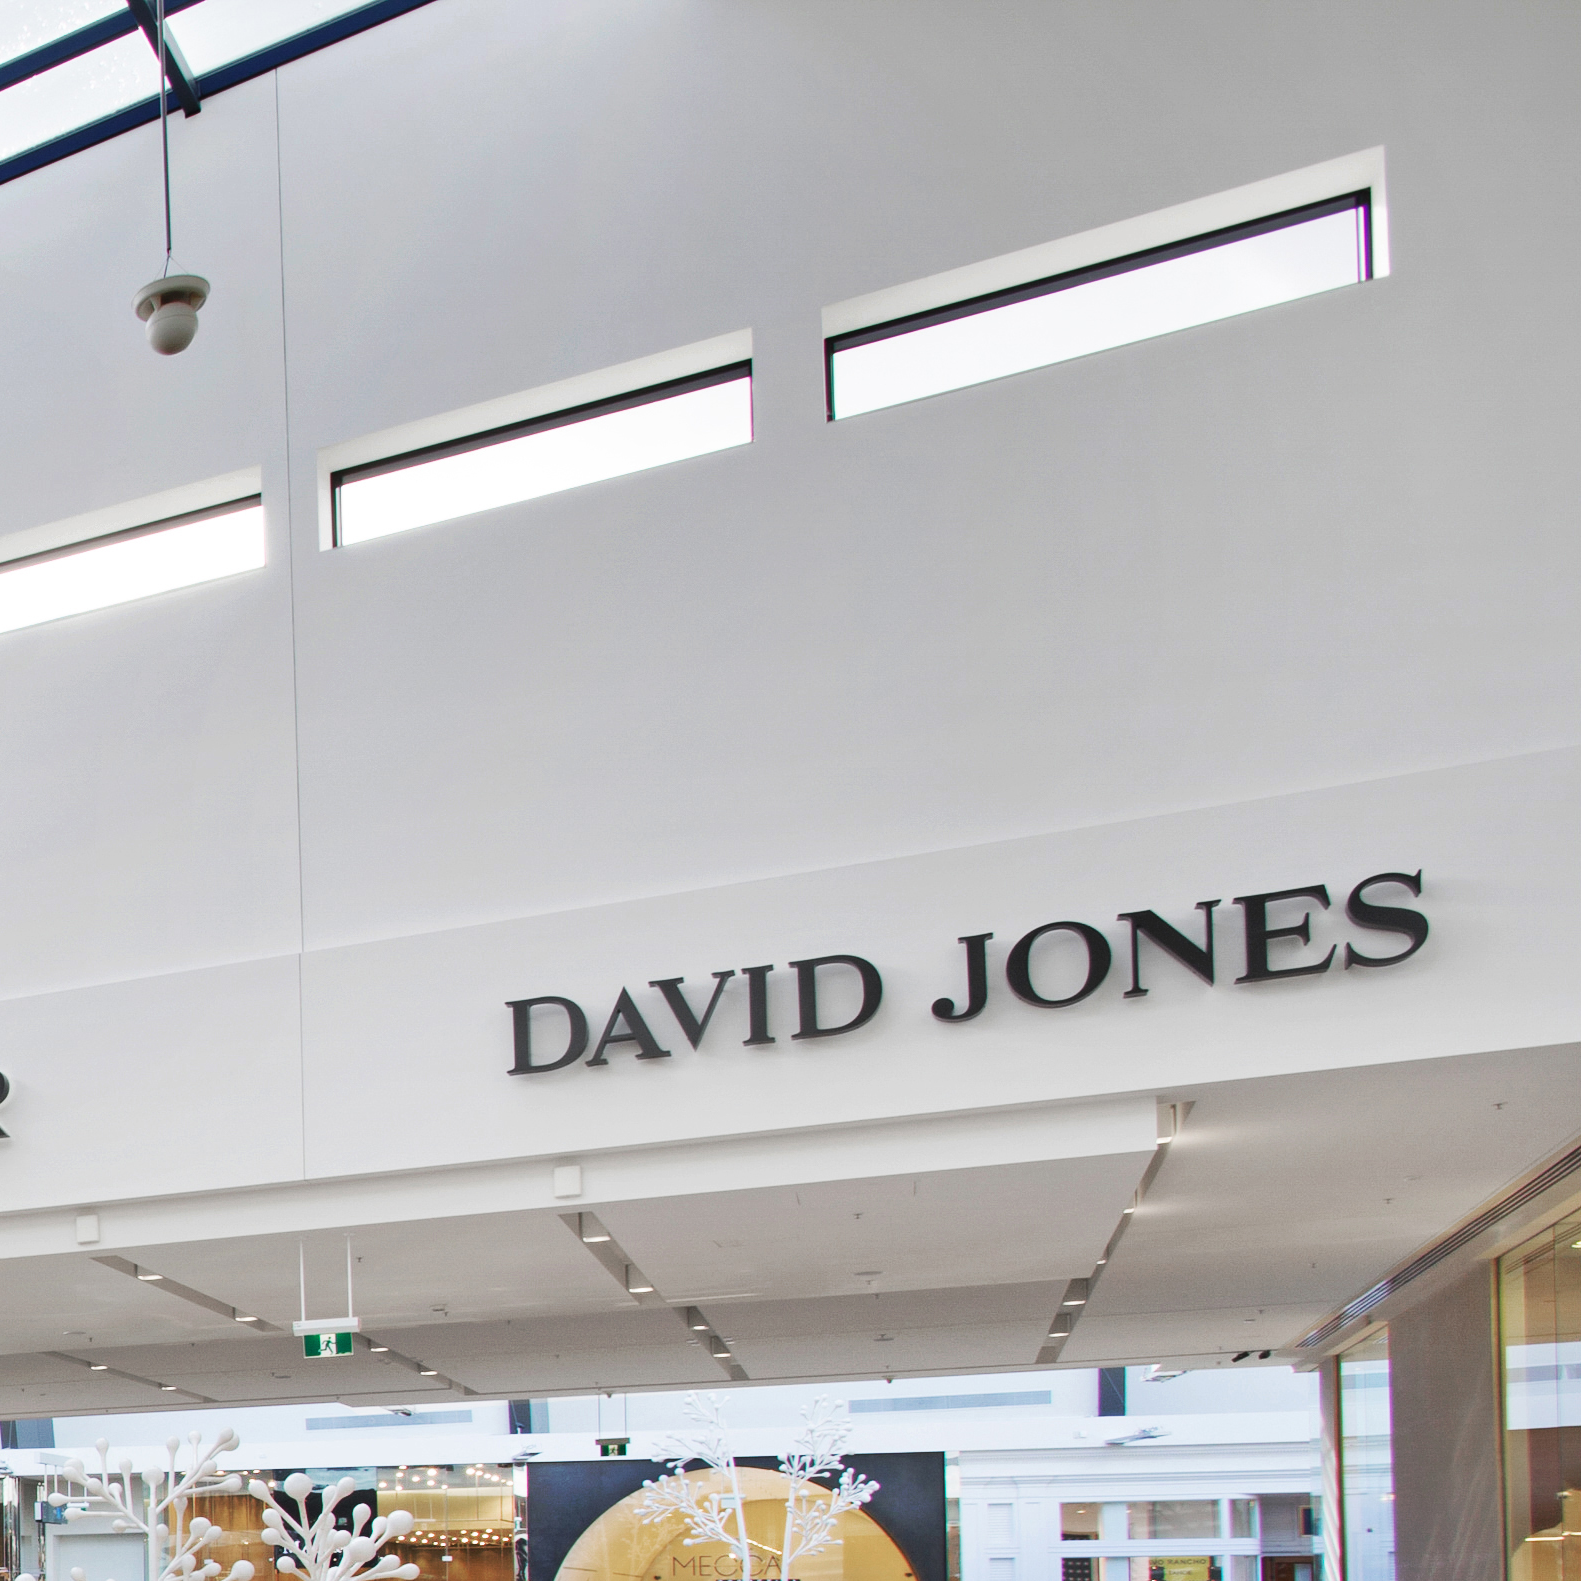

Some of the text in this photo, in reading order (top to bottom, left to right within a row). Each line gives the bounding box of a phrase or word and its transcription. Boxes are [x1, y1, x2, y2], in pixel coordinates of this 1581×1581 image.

[505, 869, 1430, 1077] DAVID JONES
[671, 1554, 783, 1577] MECCA
